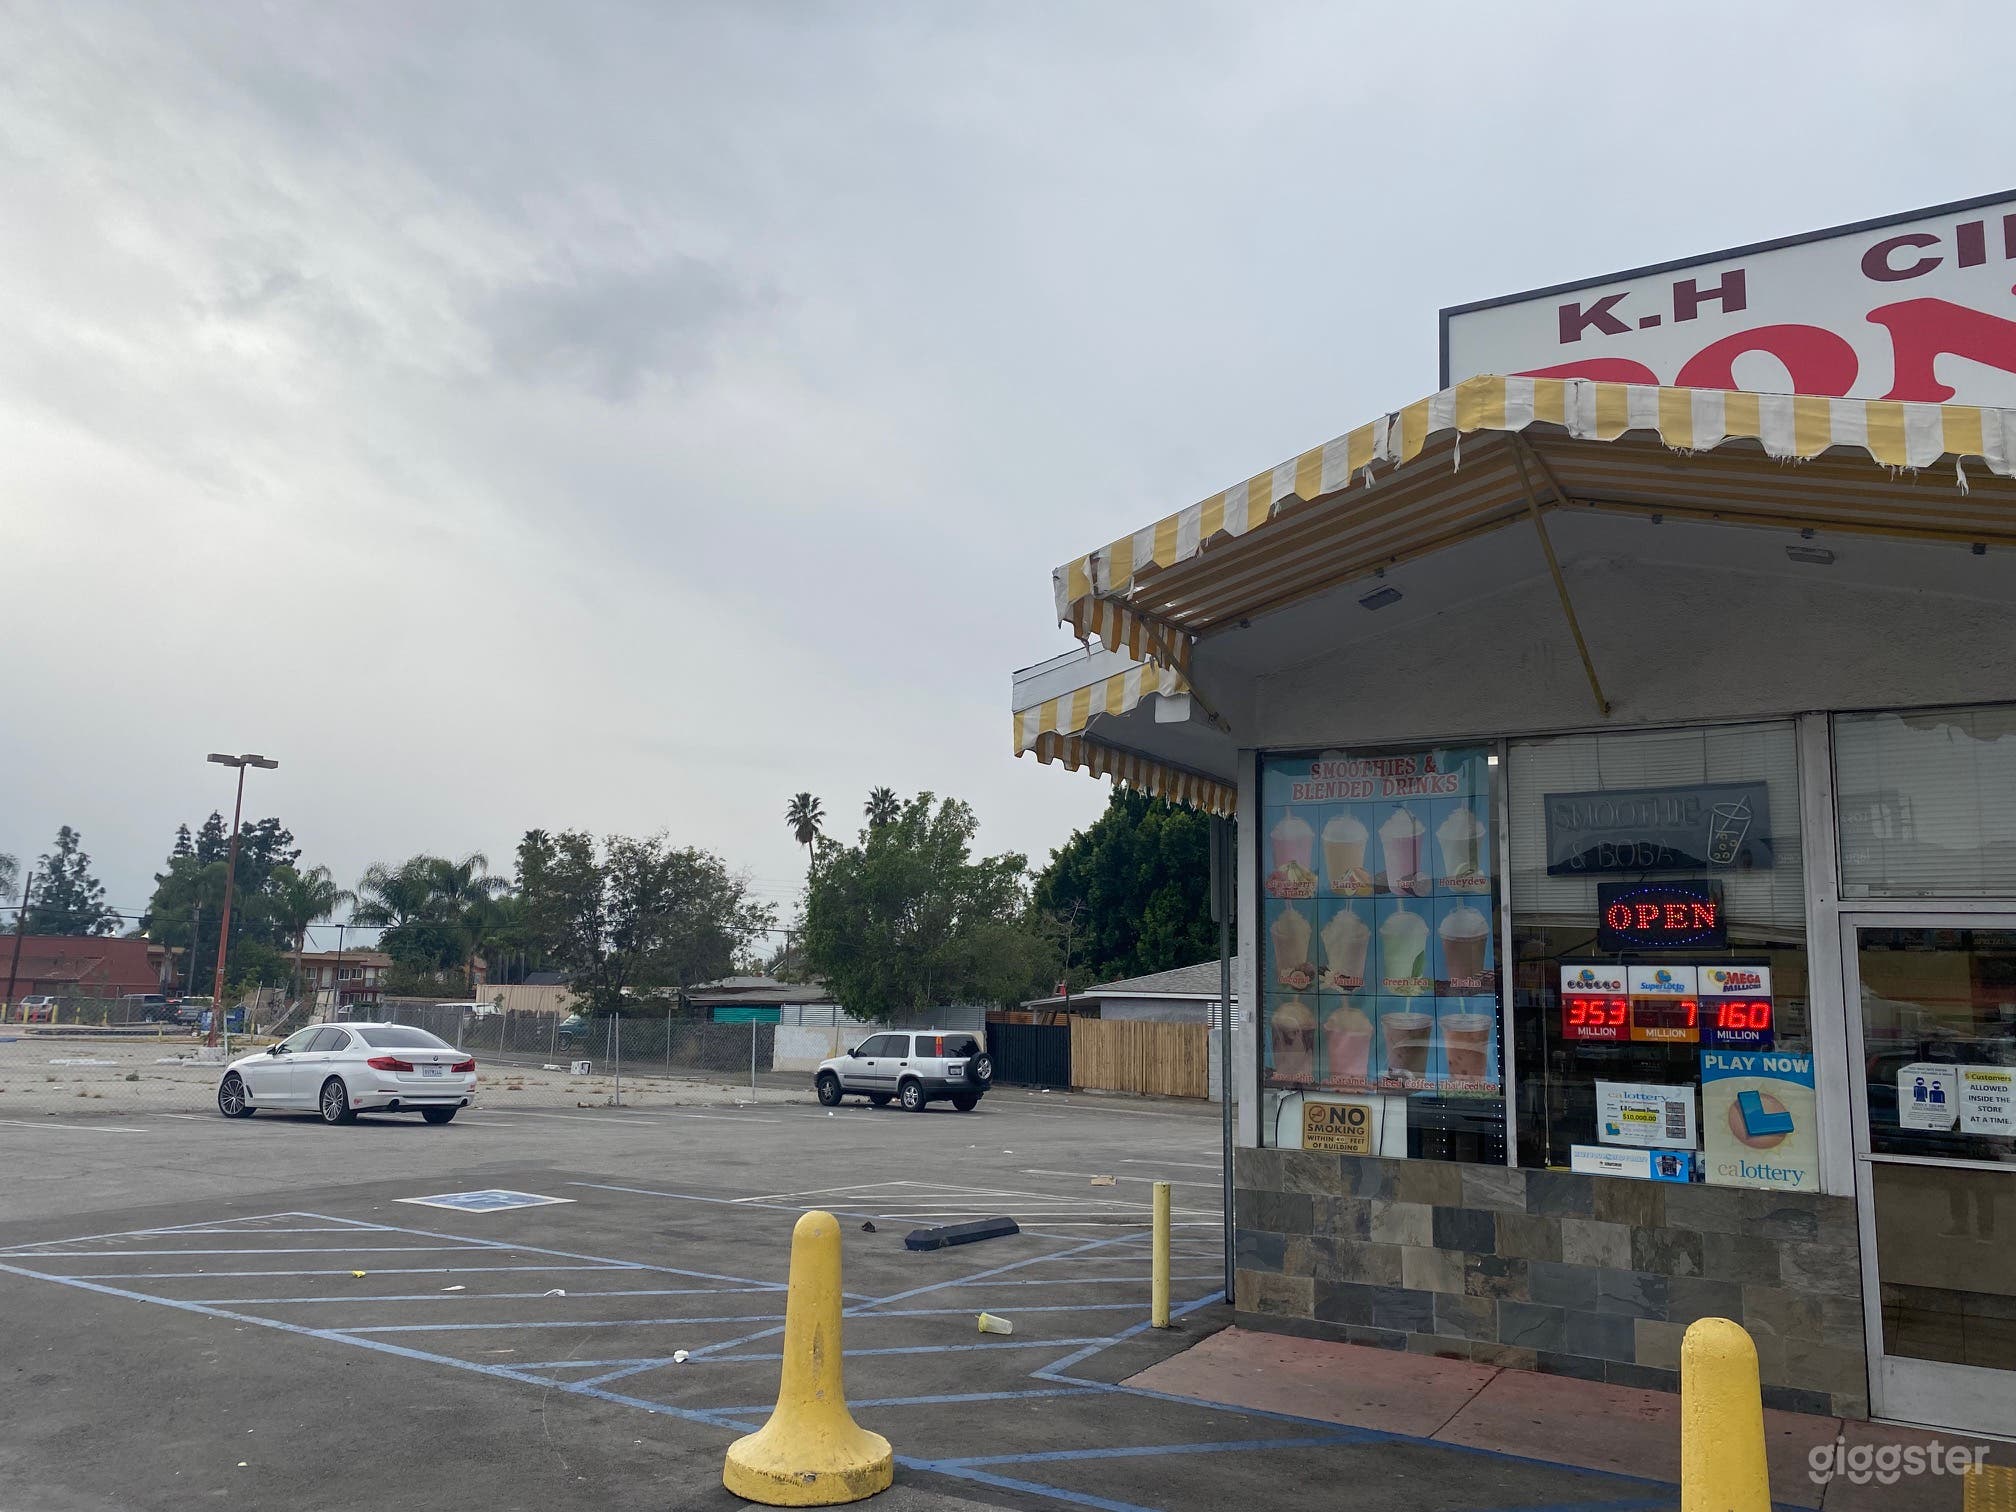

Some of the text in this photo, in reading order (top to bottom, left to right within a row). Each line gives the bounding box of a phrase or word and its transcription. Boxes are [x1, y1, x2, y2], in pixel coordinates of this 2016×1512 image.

[1559, 213, 2016, 344] K.H CI
[1511, 296, 2016, 404] ON
[1311, 755, 1437, 781] SMOOTHIES &
[1293, 775, 1458, 801] BLENDED DRINKS
[1555, 798, 1700, 830] SMOOTHIE
[1598, 839, 1674, 867] BOBA
[1439, 877, 1487, 888] Honeydew
[1607, 903, 1717, 931] OPEN
[1334, 975, 1364, 986] Vanilla
[1383, 977, 1409, 987] Green
[1450, 977, 1482, 988] Mocha
[1726, 971, 1761, 985] MEGA
[1569, 1000, 1626, 1026] 353
[1680, 1001, 1697, 1026] 7
[1717, 1002, 1771, 1029] 160
[1577, 1027, 1617, 1037] MILLION
[1645, 1028, 1686, 1038] MILLION
[1717, 1030, 1760, 1041] MILLION
[1705, 1055, 1809, 1074] PLAY NOW
[1381, 1077, 1435, 1089] Iced Coffee
[1971, 1073, 2012, 1083] Customers
[1440, 1080, 1497, 1091] Thai Iced Tea
[1970, 1085, 2008, 1093] ALLOWED
[1968, 1095, 2012, 1104] INSIDE THE
[1977, 1105, 2003, 1113] STORE
[1329, 1106, 1366, 1126] NO
[1970, 1116, 1980, 1124] AT
[1307, 1123, 1365, 1136] SMOKING
[1307, 1134, 1334, 1144] WITHIN
[1350, 1137, 1365, 1145] FEET
[1324, 1143, 1359, 1152] BUILDING
